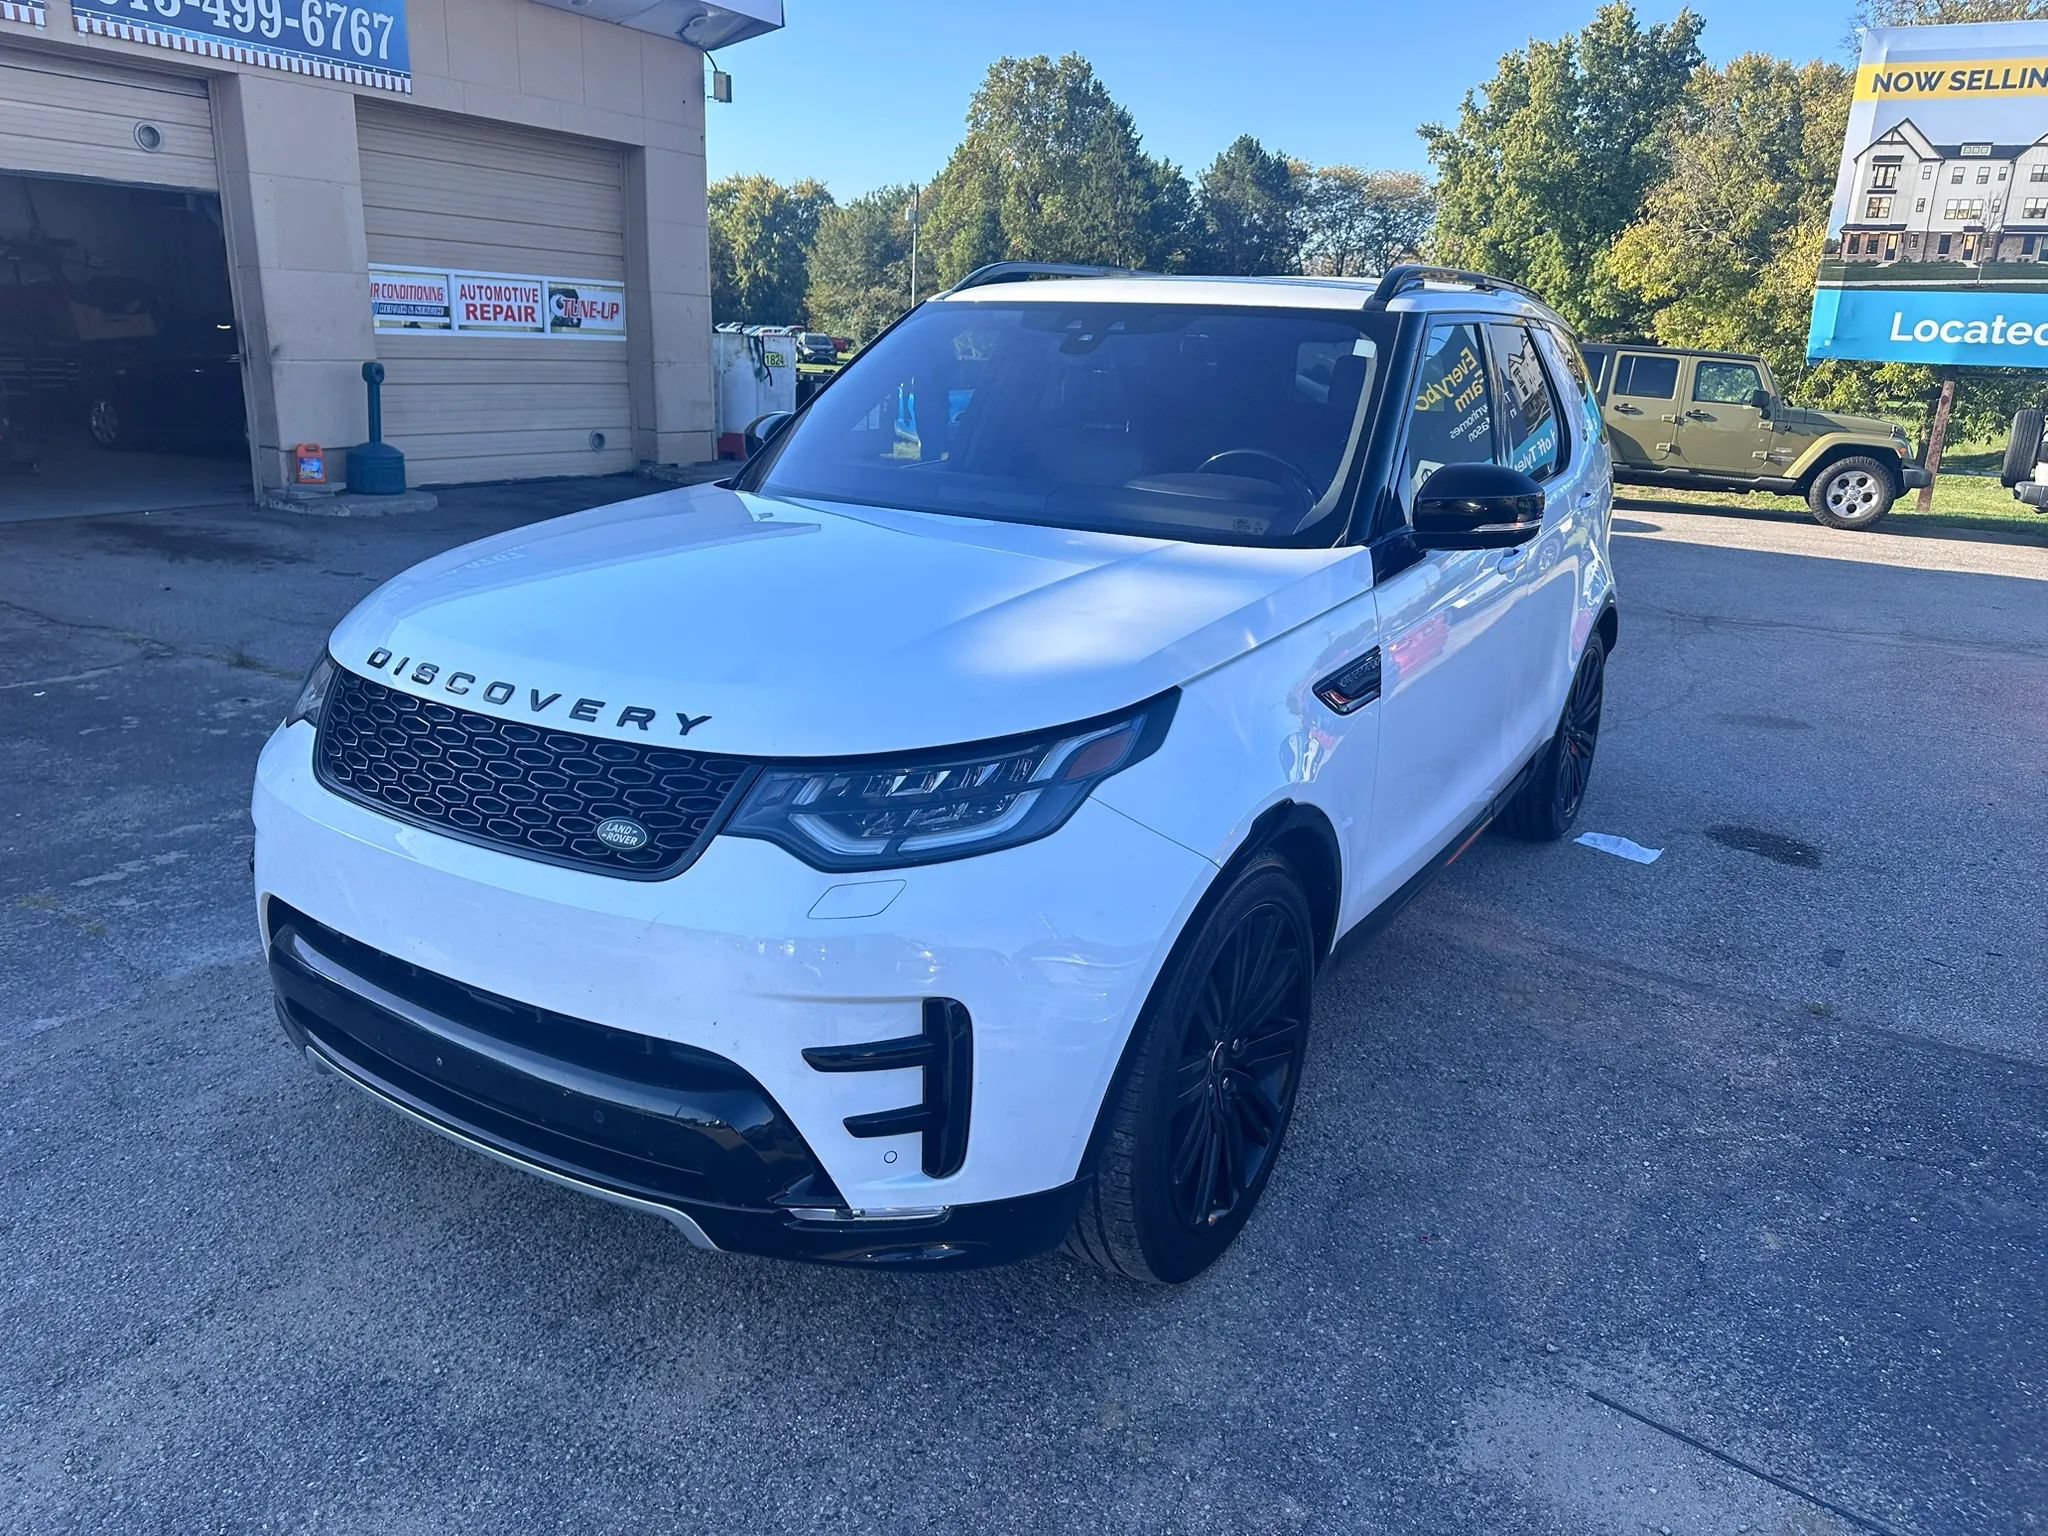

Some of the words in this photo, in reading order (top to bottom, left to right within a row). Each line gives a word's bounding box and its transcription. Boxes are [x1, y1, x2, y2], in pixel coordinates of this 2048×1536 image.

[98, 0, 394, 60] -499-6767
[1872, 71, 1945, 93] NOW
[370, 282, 380, 298] IR
[381, 283, 443, 301] CONDITIONING
[459, 284, 539, 303] AUTOMOTIVE
[465, 303, 537, 322] REPAIR
[563, 299, 619, 320] TUNE-UP
[766, 354, 784, 366] 1824
[366, 646, 713, 736] DISCOVERY
[606, 823, 632, 835] LAND
[606, 832, 638, 845] ROVER
